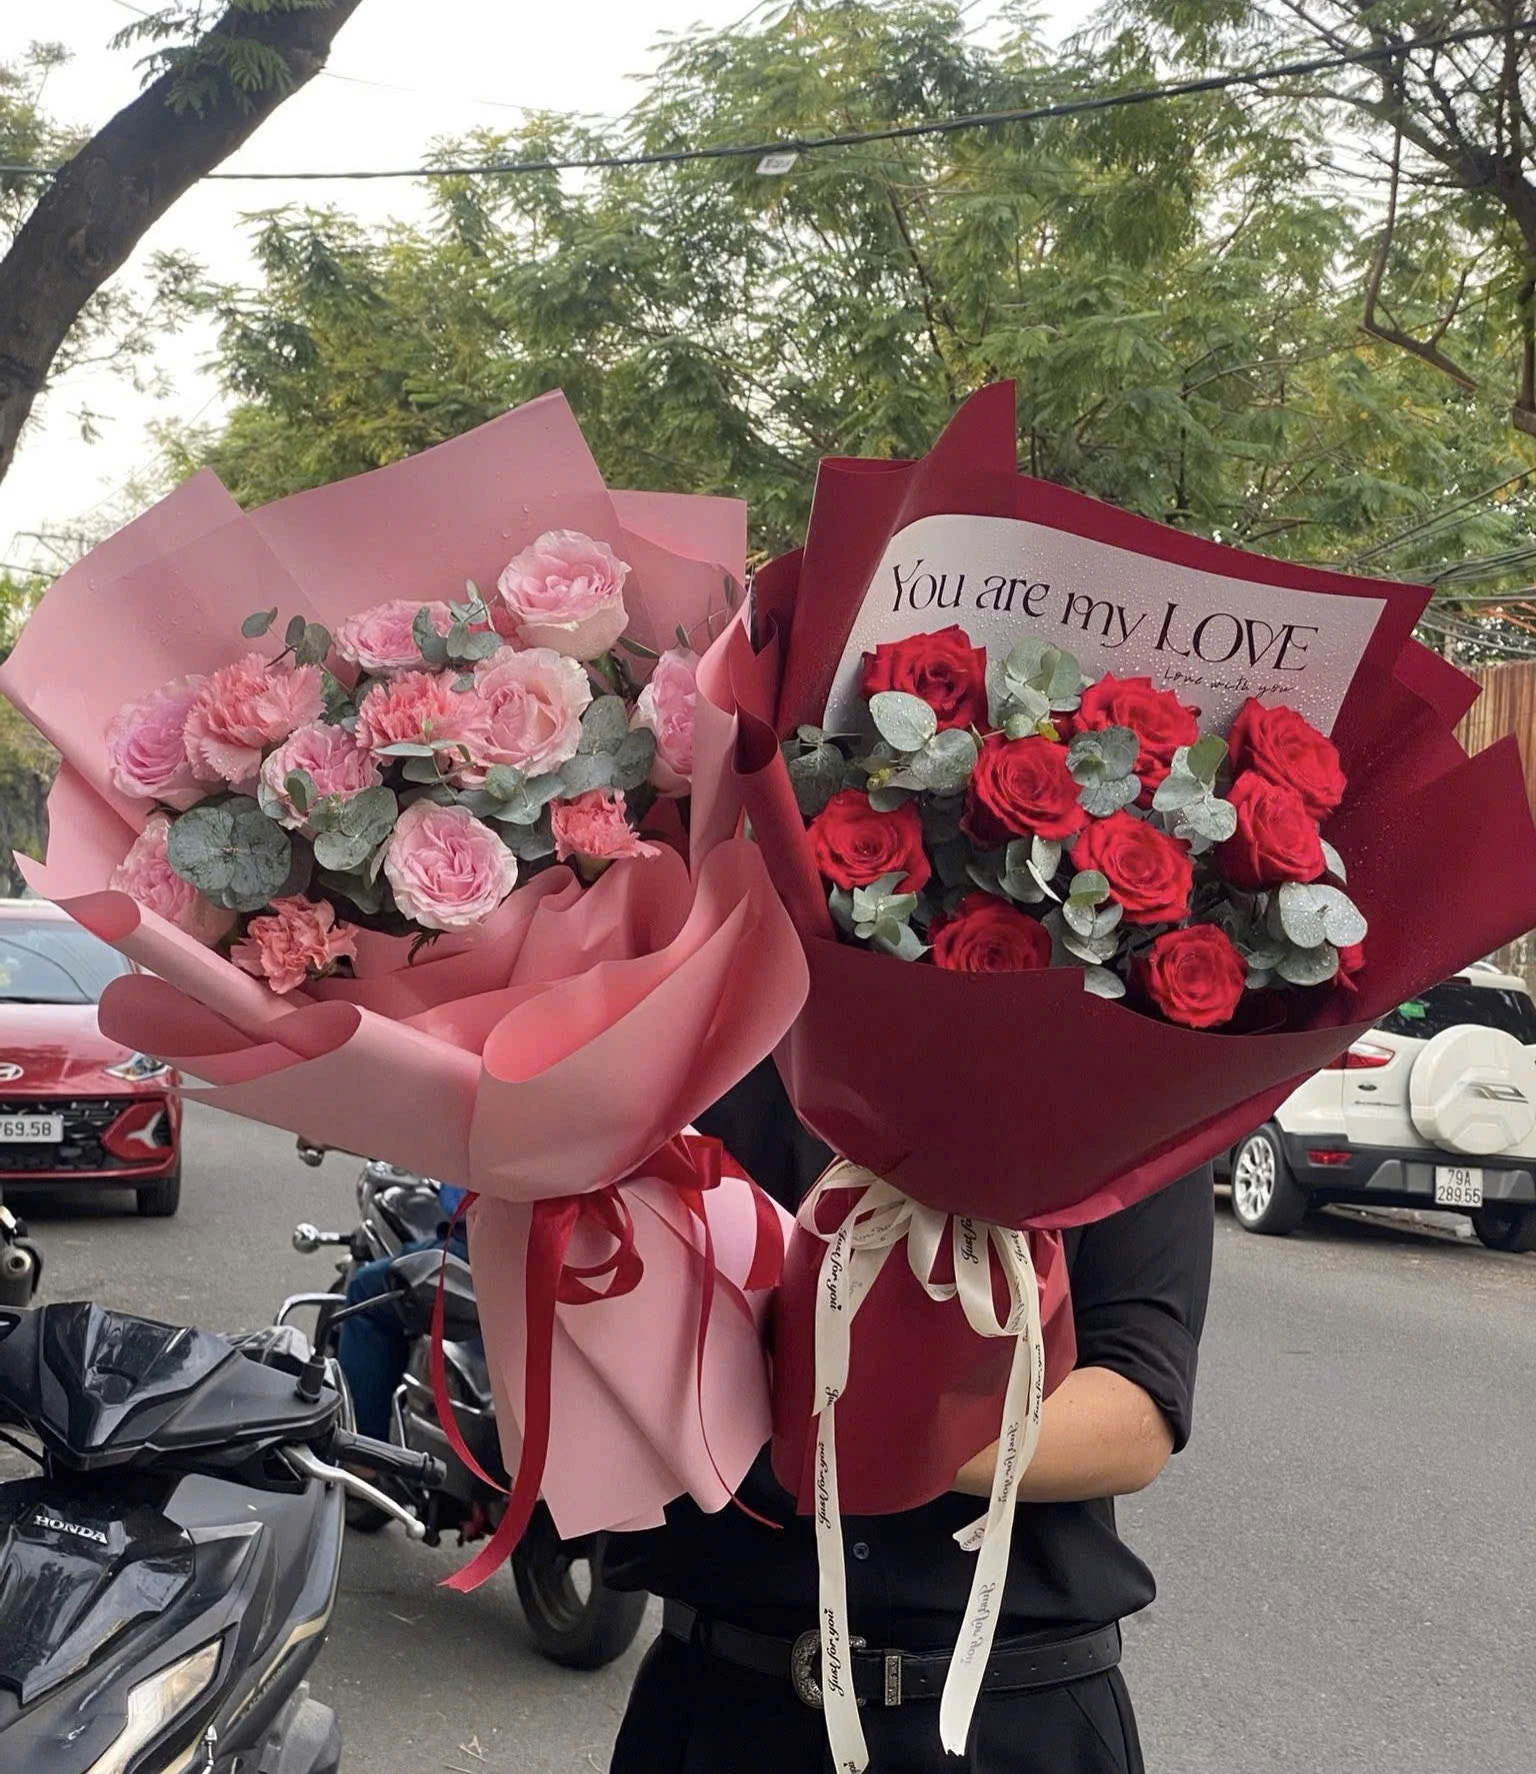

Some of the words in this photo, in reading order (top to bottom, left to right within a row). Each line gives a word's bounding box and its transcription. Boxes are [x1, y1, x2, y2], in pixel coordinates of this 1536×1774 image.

[892, 558, 966, 613] You
[975, 574, 1051, 618] are
[1060, 591, 1148, 649] my
[1153, 601, 1320, 672] LOVE
[1164, 666, 1203, 685] Love
[1210, 673, 1250, 691] with
[1255, 682, 1298, 699] you
[1447, 1168, 1472, 1187] 79A
[830, 1227, 848, 1258] Just
[830, 1253, 844, 1281] for
[825, 1278, 838, 1312] you
[819, 1442, 828, 1473] you
[817, 1470, 829, 1498] for
[818, 1494, 832, 1529] Just
[33, 1514, 108, 1545] HONDA
[828, 1610, 840, 1642] you
[826, 1638, 841, 1663] for
[828, 1660, 845, 1697] Just
